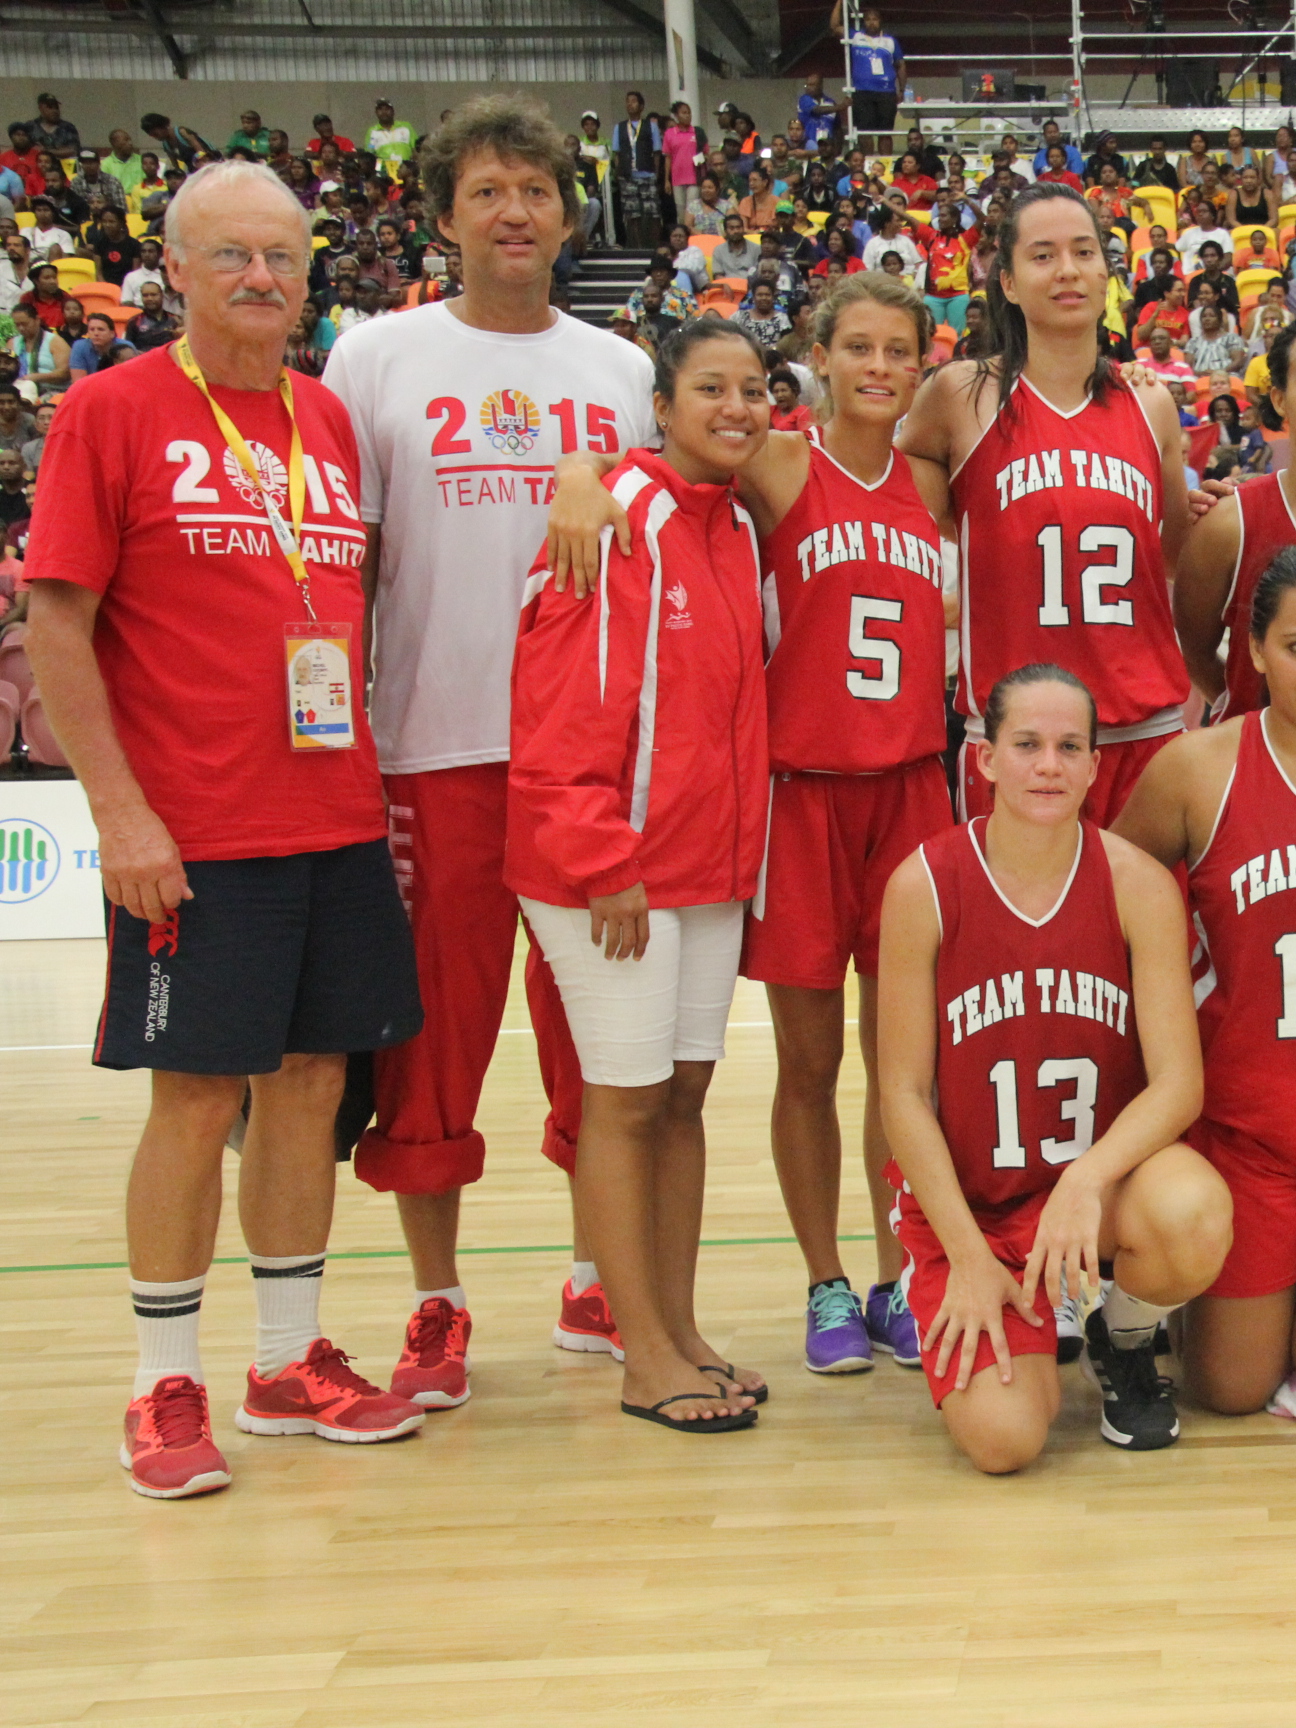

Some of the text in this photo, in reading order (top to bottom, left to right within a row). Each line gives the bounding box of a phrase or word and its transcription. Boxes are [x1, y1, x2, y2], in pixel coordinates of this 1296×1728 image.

[437, 476, 516, 508] TEAM
[996, 449, 1153, 523] TEAM TAHITI
[180, 528, 366, 568] TEAM AHITI
[797, 521, 866, 583] TEAM
[1036, 524, 1135, 627] 12
[846, 593, 904, 701] 5
[144, 962, 161, 1042] OF NEW ZEALAND
[157, 974, 171, 1032] CANTERBURY
[947, 968, 1129, 1046] TEAM TAHITI
[988, 1057, 1099, 1170] 13
